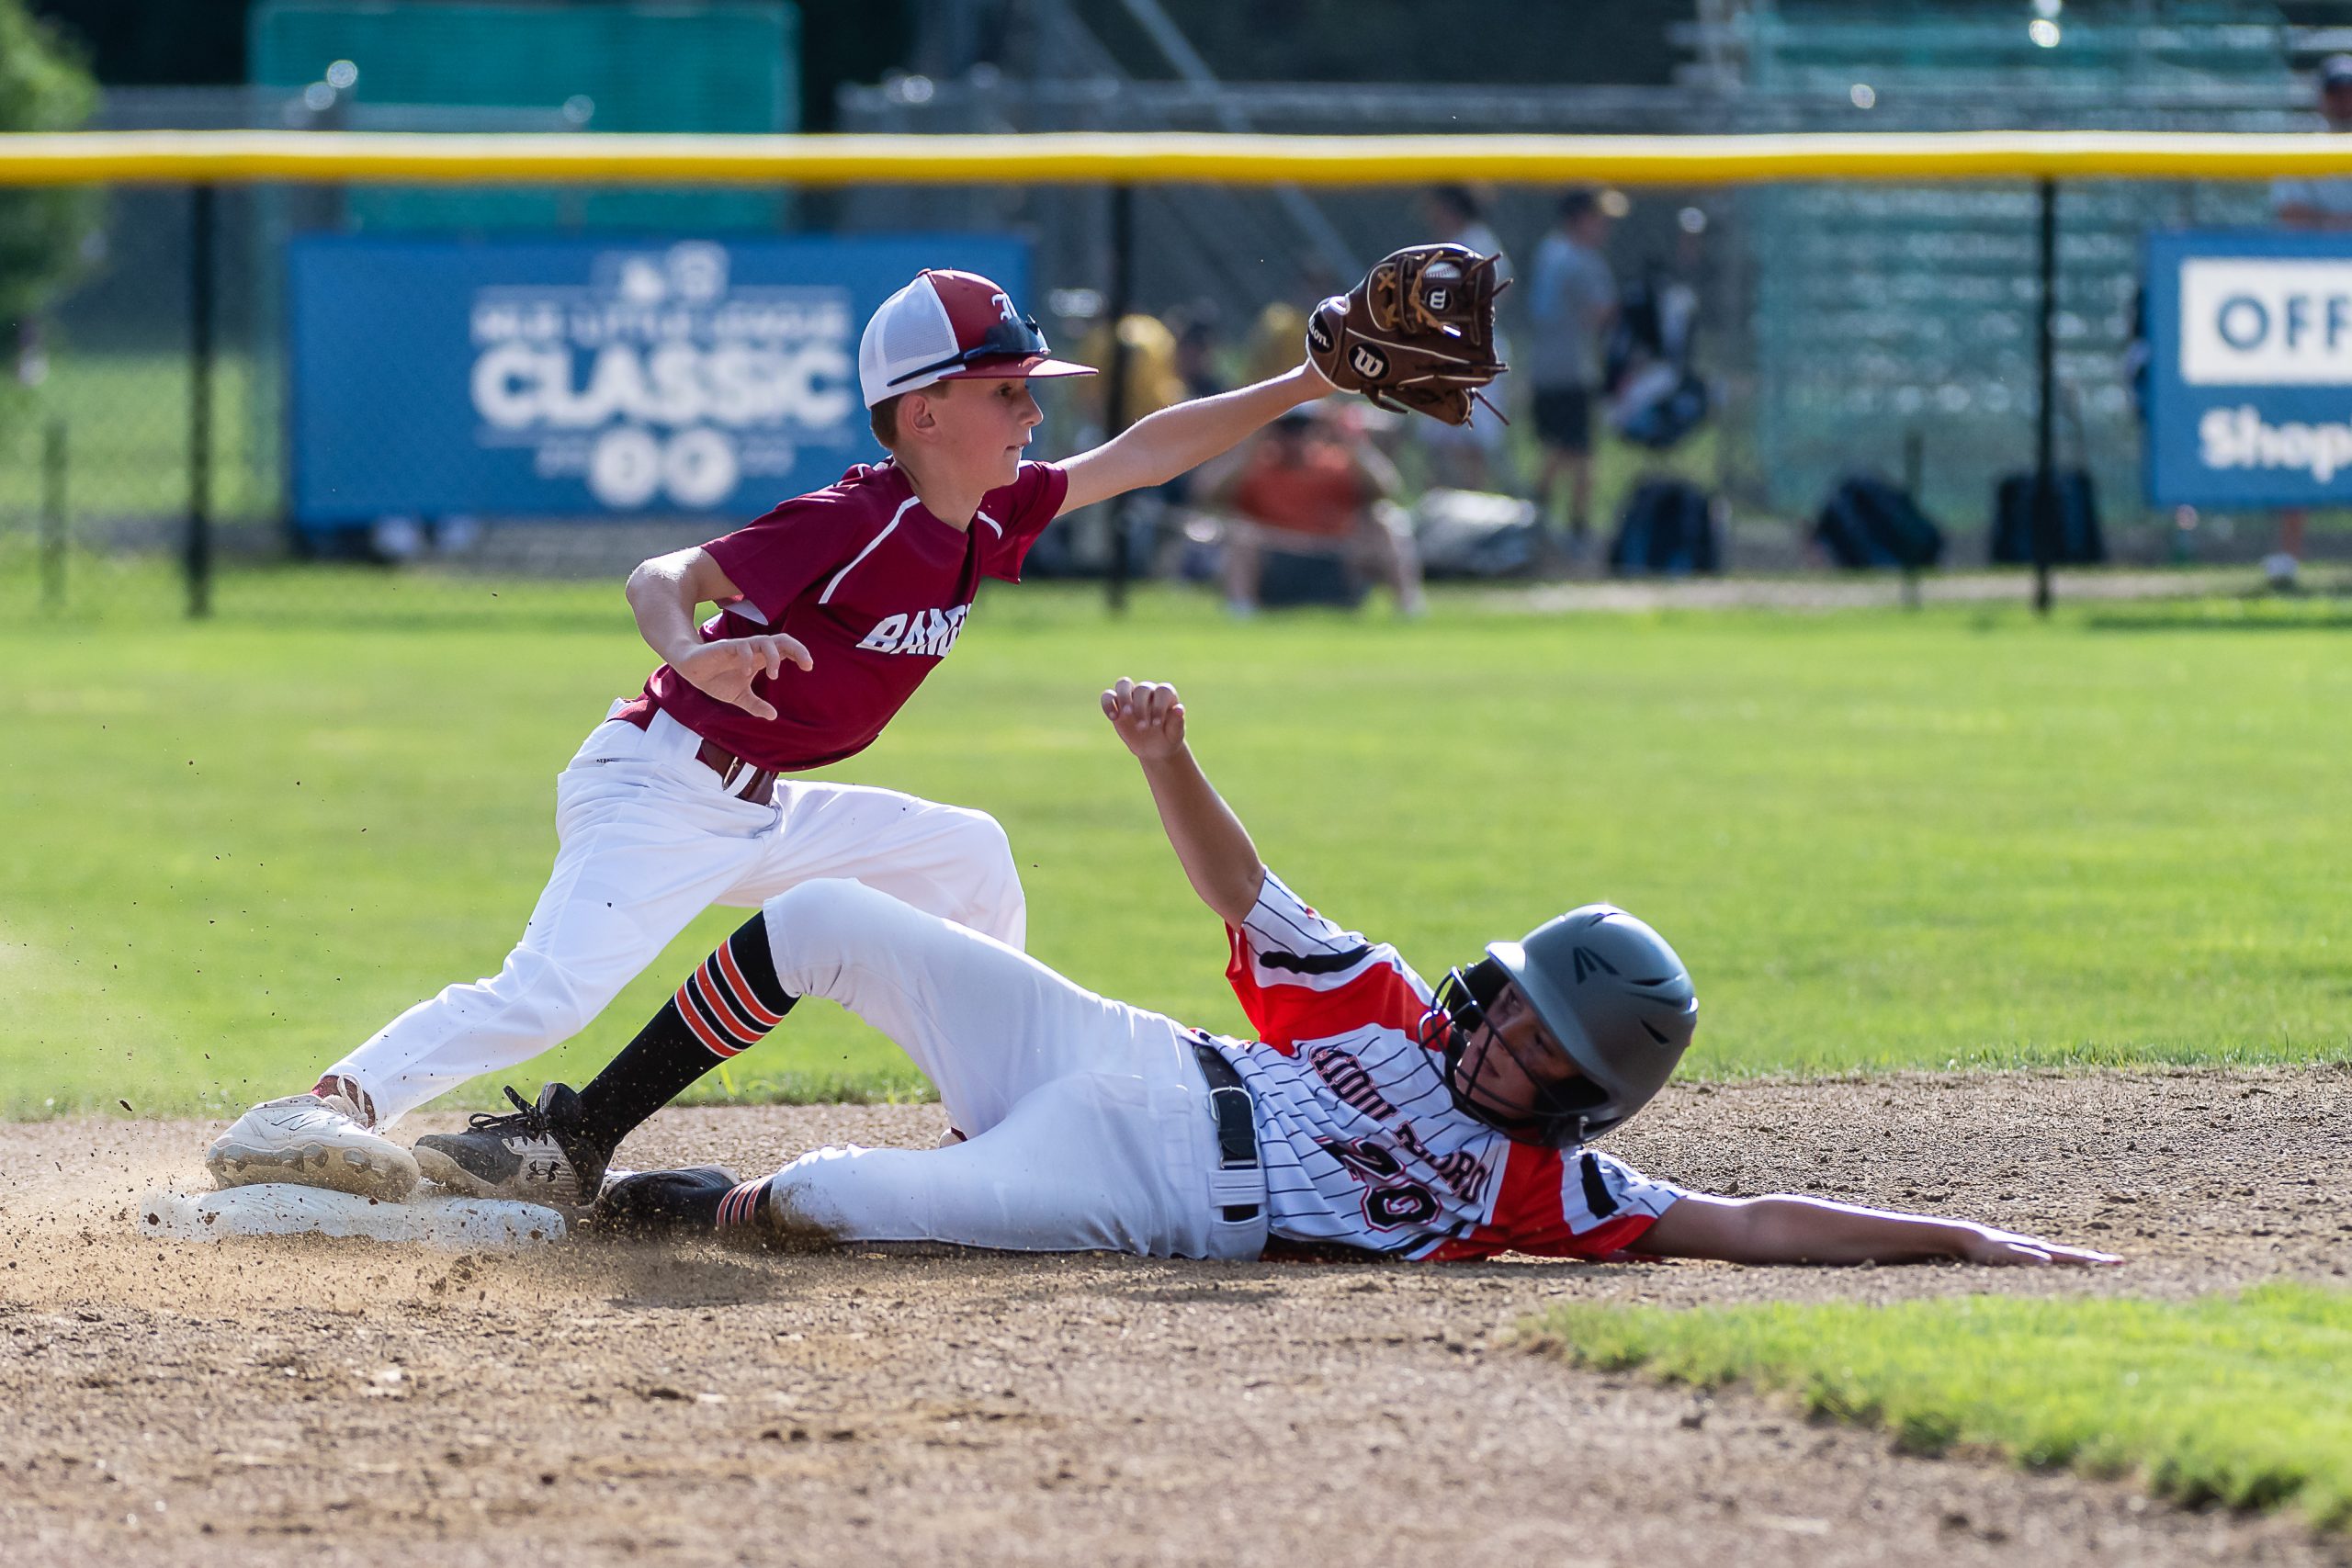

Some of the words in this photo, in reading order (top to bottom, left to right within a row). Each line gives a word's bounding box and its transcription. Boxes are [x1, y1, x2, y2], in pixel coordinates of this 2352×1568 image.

[471, 340, 854, 427] CLASSIC
[1354, 344, 1385, 378] W
[855, 603, 972, 658] BANG
[1314, 1135, 1443, 1234] 20
